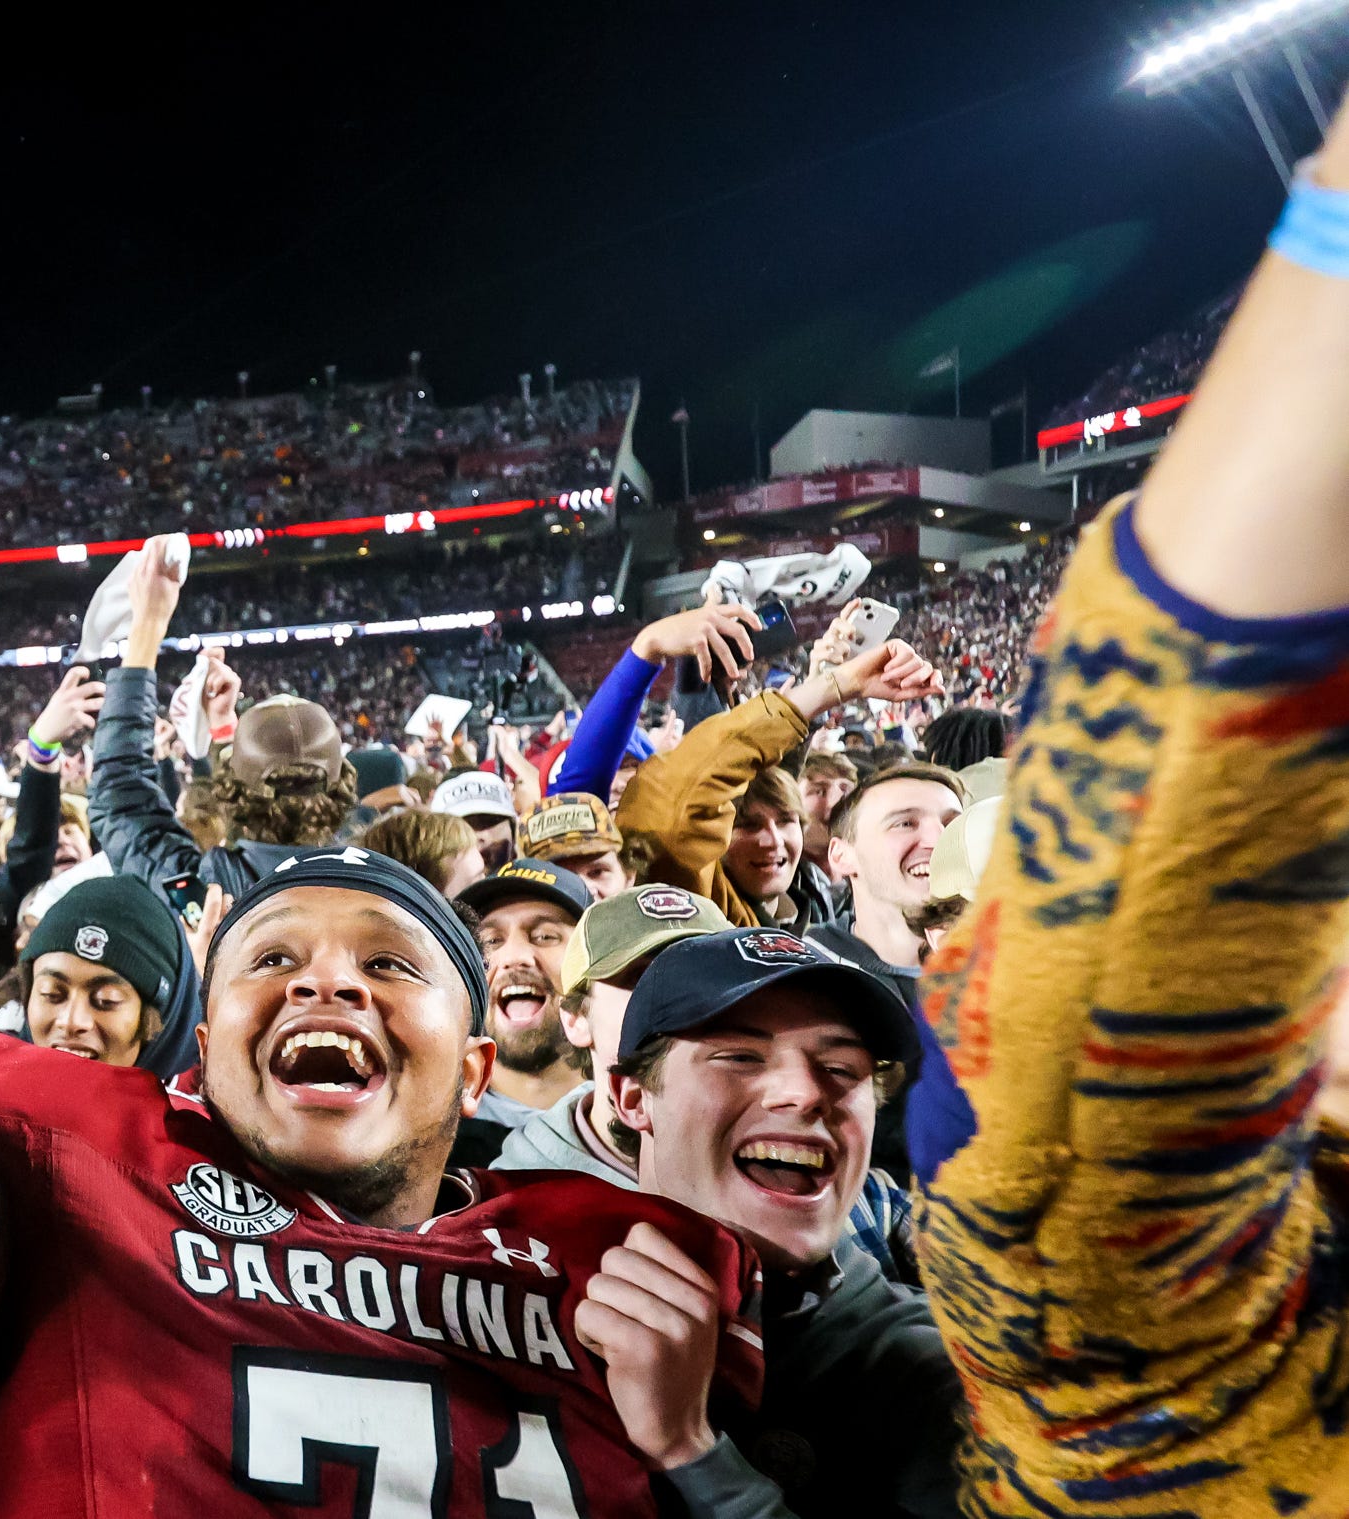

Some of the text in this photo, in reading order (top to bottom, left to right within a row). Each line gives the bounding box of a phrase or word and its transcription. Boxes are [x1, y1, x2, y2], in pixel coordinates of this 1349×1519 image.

[194, 1165, 270, 1214] SEC
[184, 1198, 282, 1235] GRADUATE
[175, 1228, 576, 1372] CAROLINA
